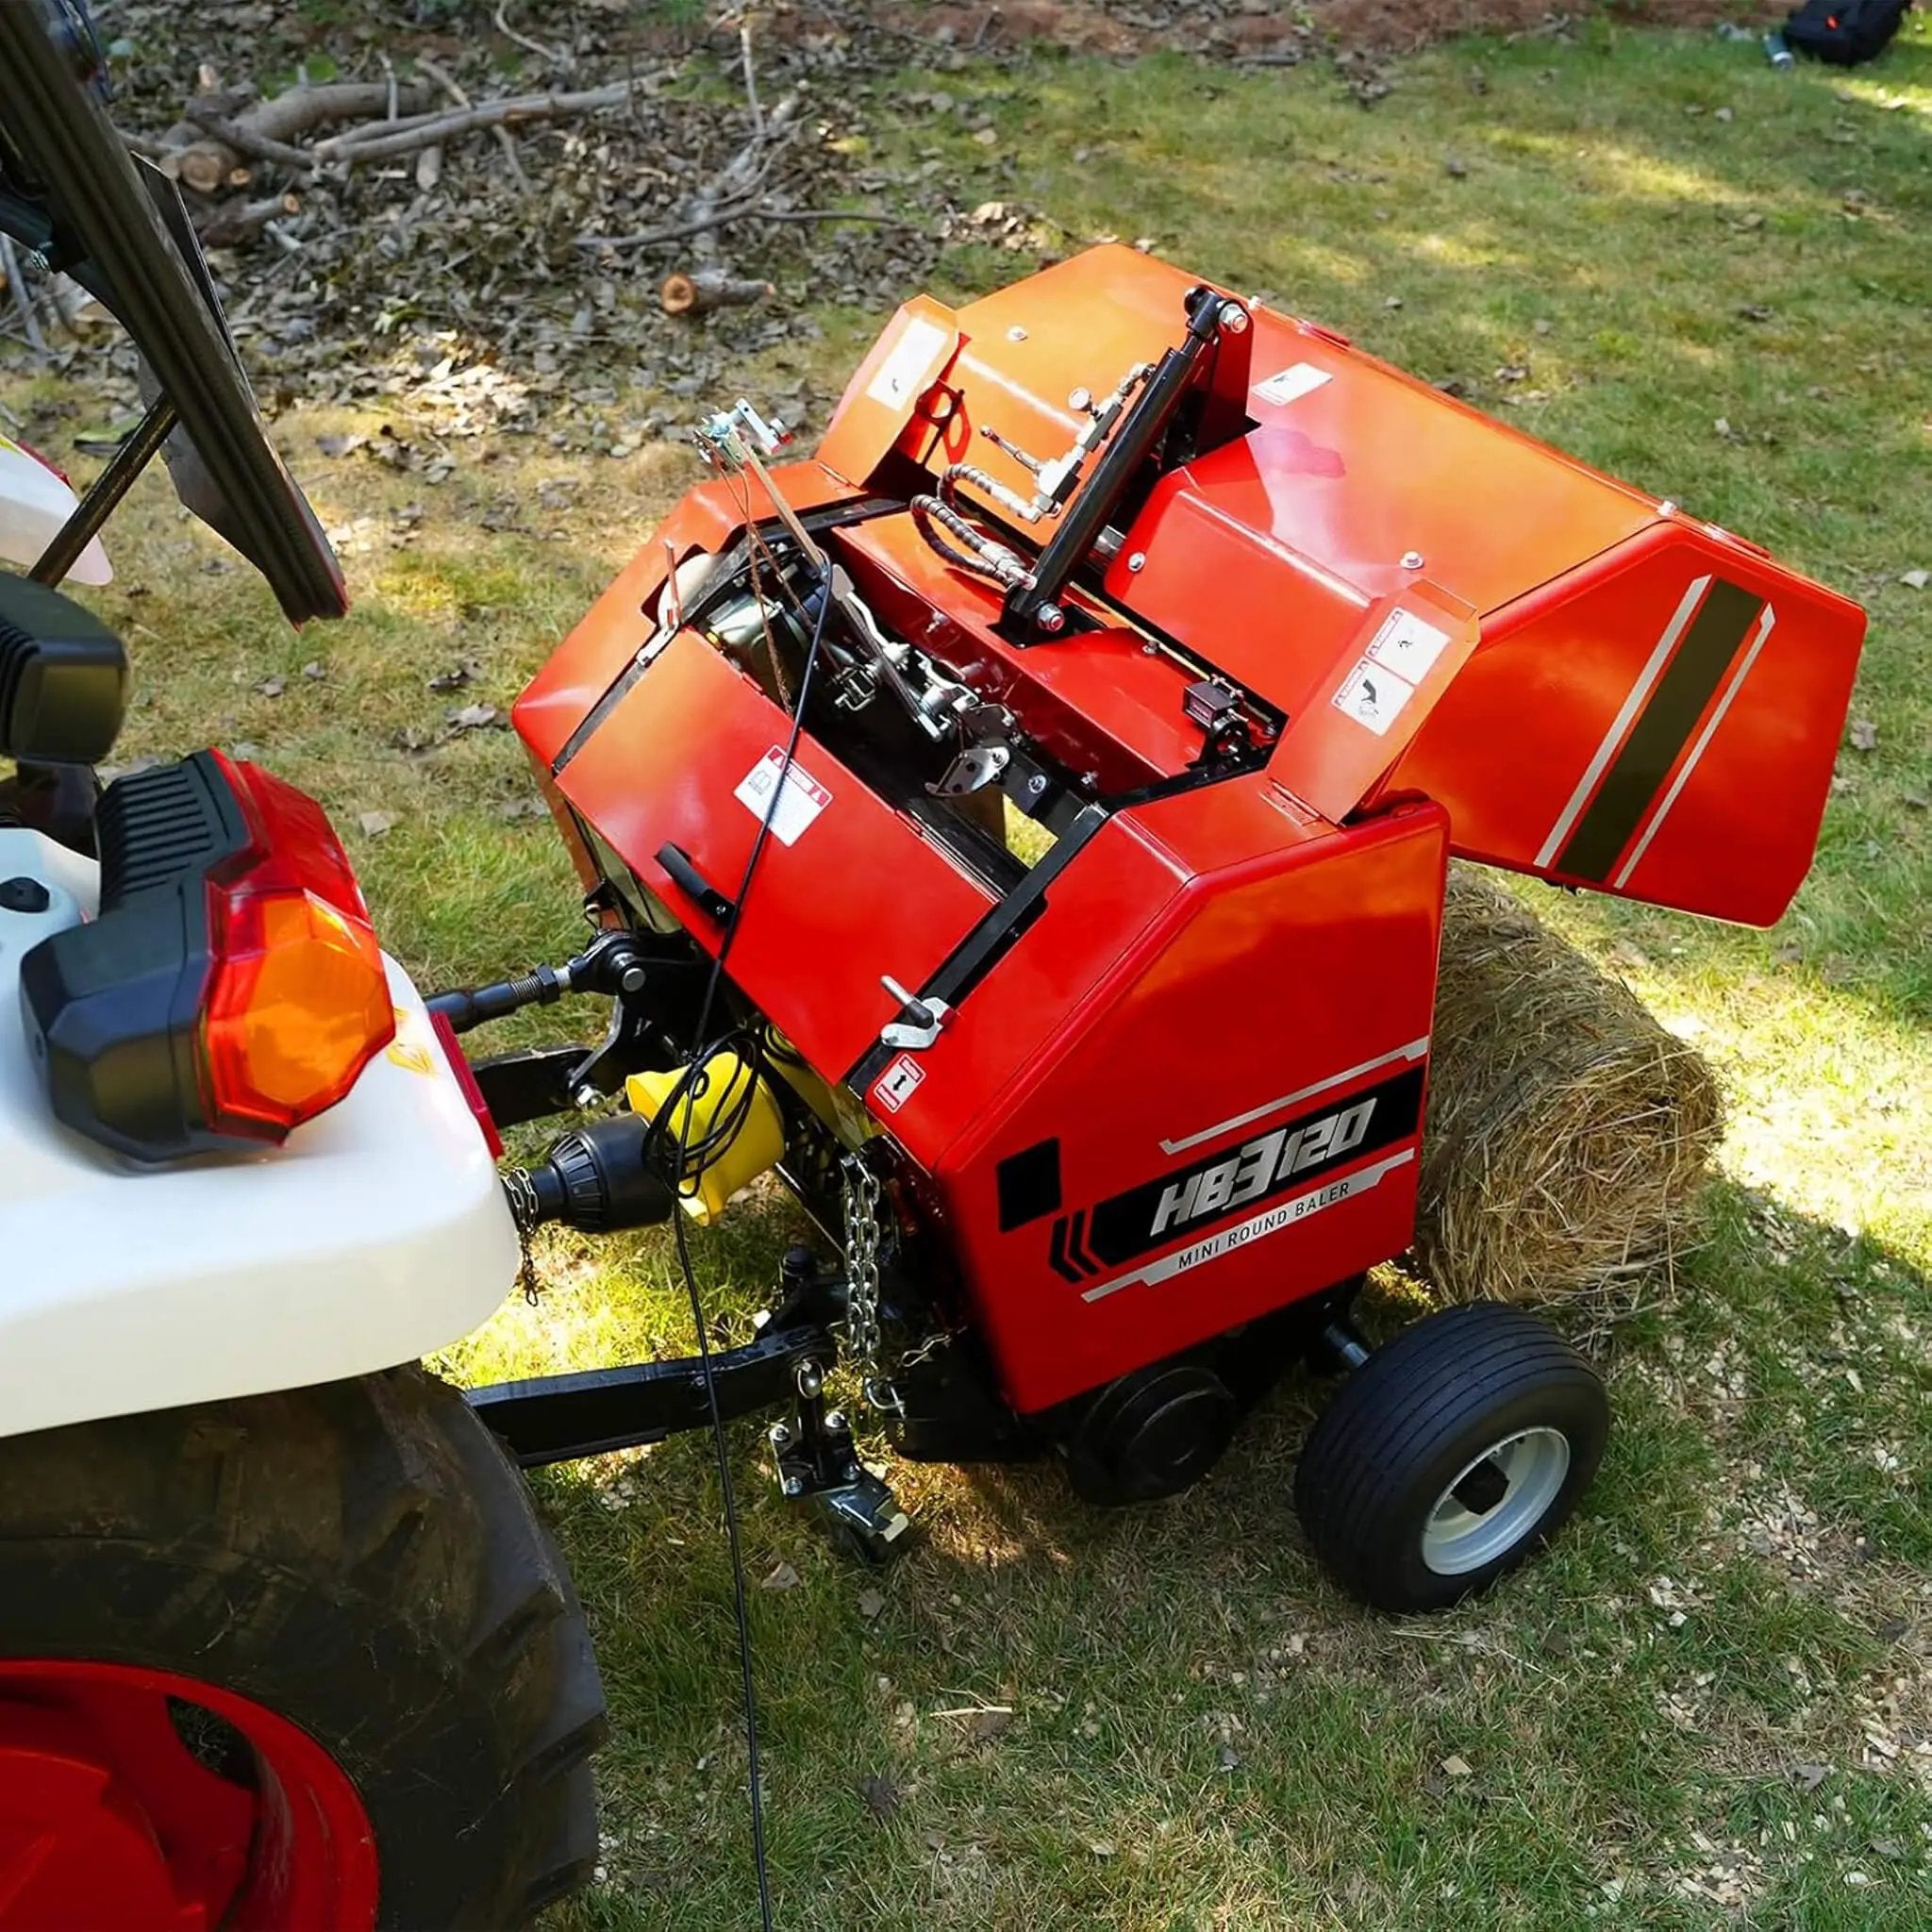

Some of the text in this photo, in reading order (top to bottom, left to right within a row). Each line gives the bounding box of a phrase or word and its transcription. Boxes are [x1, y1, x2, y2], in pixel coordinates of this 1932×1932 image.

[1150, 1097, 1377, 1237] HB3120
[1179, 1182, 1350, 1269] MINI ROUND BALER
